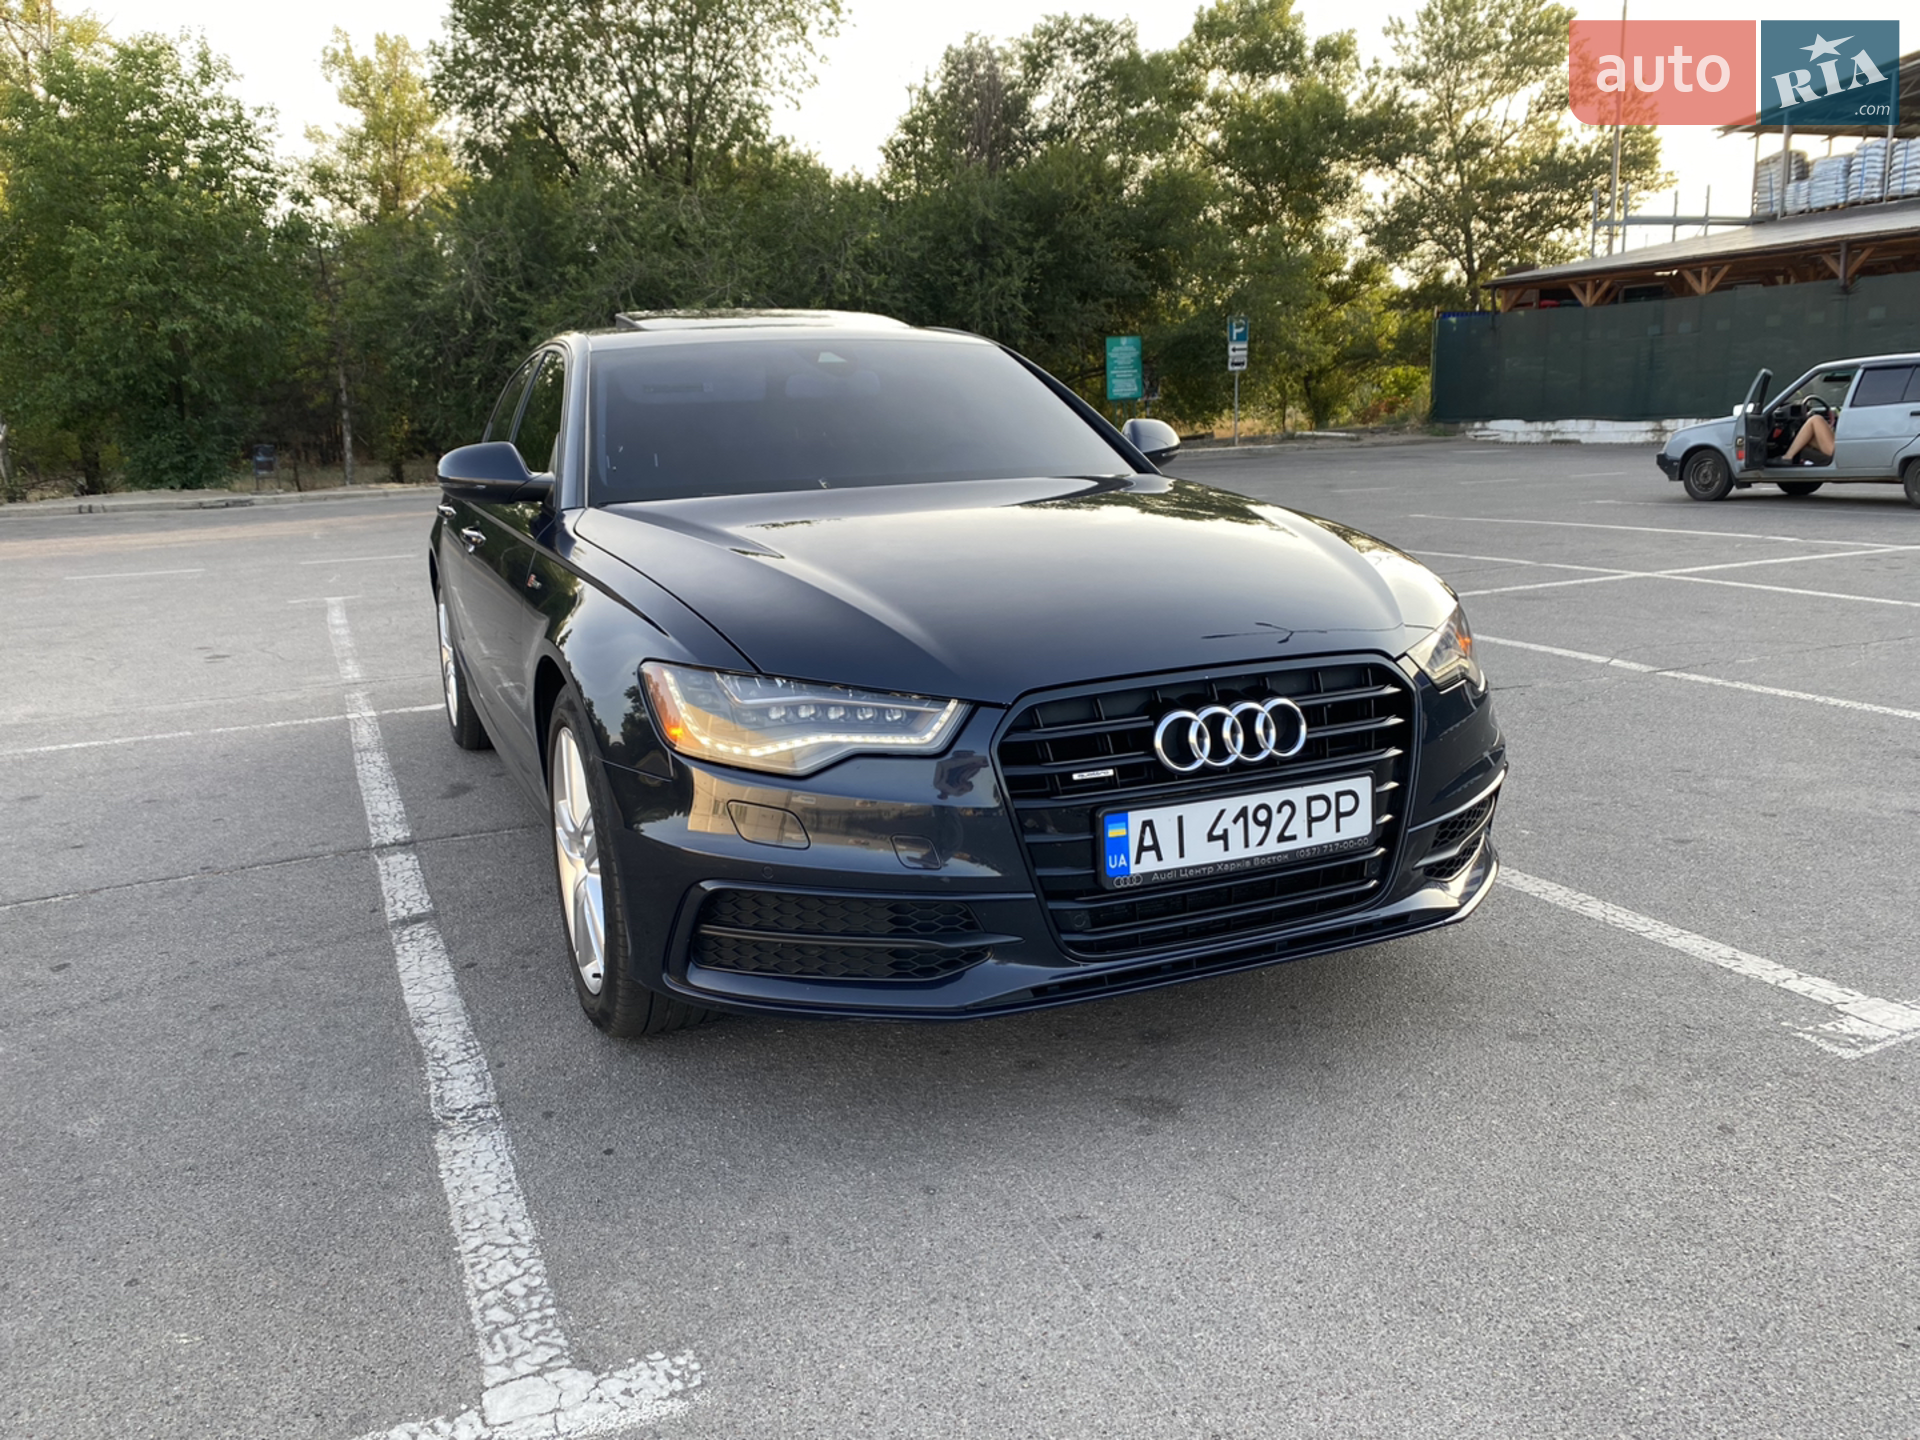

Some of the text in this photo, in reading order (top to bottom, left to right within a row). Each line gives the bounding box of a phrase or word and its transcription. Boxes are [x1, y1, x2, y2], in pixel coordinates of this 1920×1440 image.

[1232, 319, 1246, 340] P
[1108, 854, 1127, 868] UA
[1151, 870, 1177, 882] Audi
[1180, 864, 1214, 879] Центр
[1253, 854, 1290, 866] Восток
